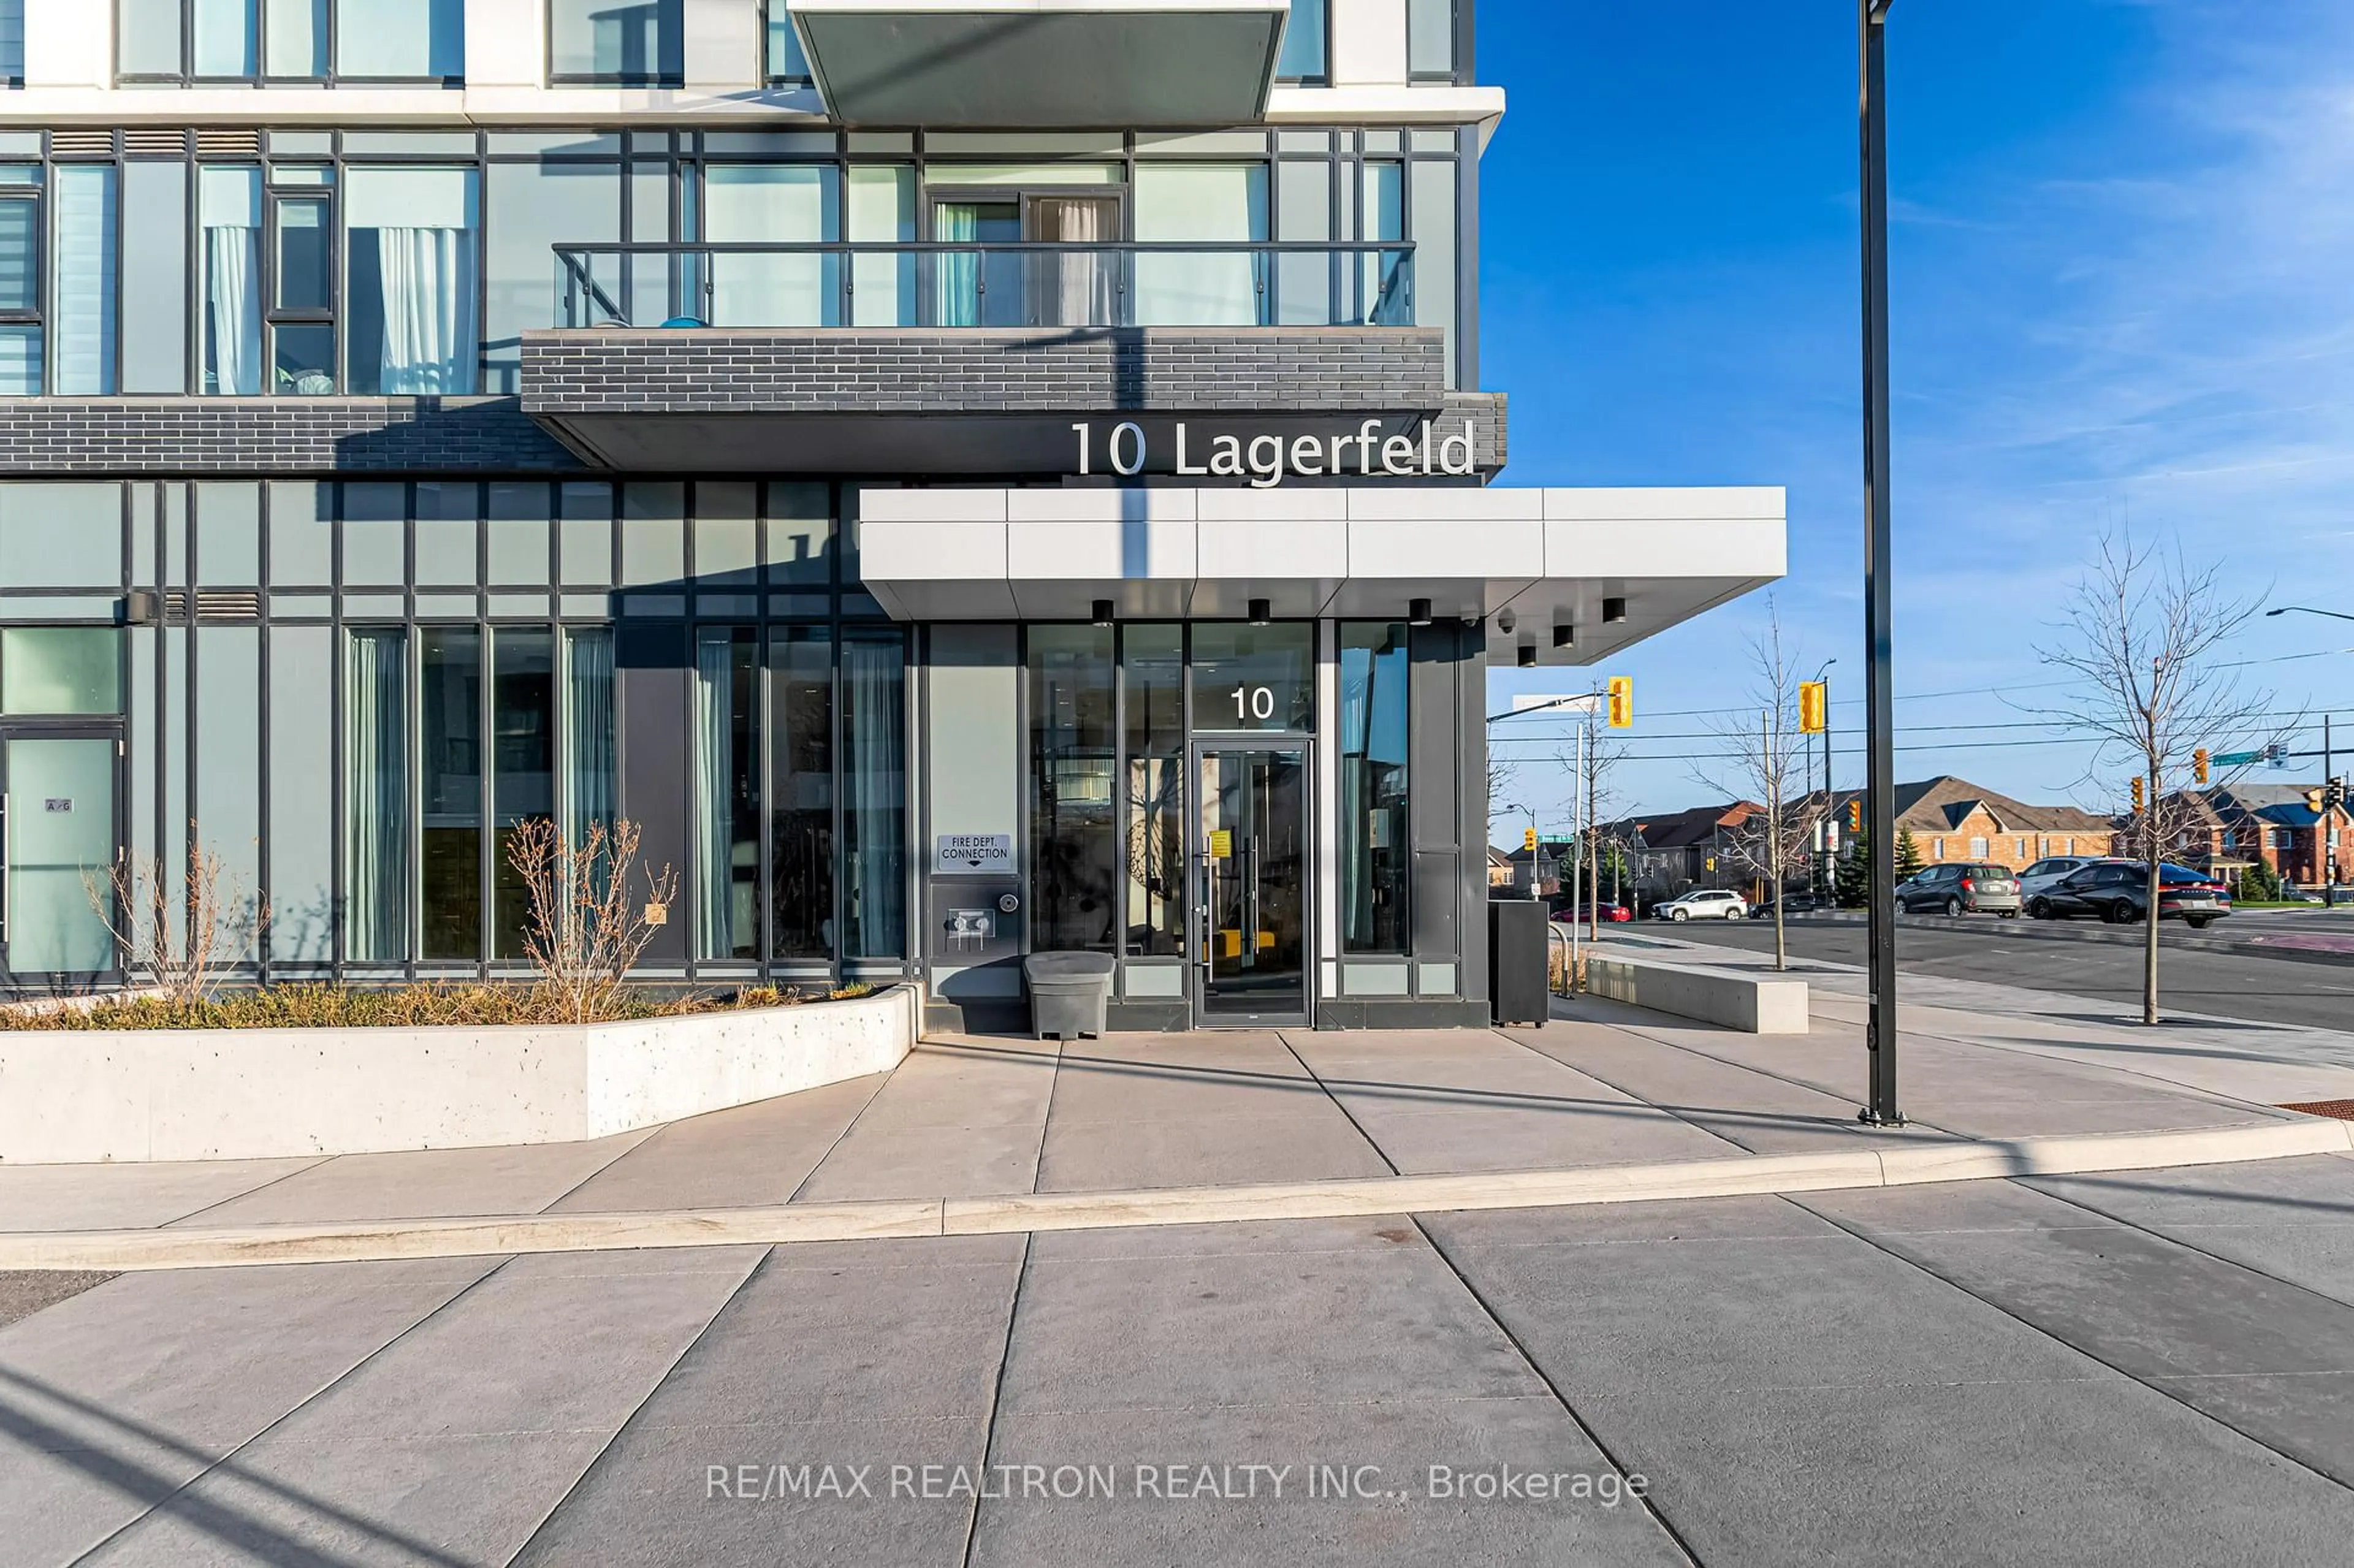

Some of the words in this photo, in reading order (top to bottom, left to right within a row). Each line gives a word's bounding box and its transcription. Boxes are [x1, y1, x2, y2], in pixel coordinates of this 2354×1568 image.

[1071, 422, 1147, 475] 10
[1175, 420, 1474, 488] Lagerfeld
[1230, 687, 1274, 720] 10
[952, 837, 970, 847] FIRE
[973, 837, 997, 847] DEPT.
[942, 848, 1008, 859] CONNECTION
